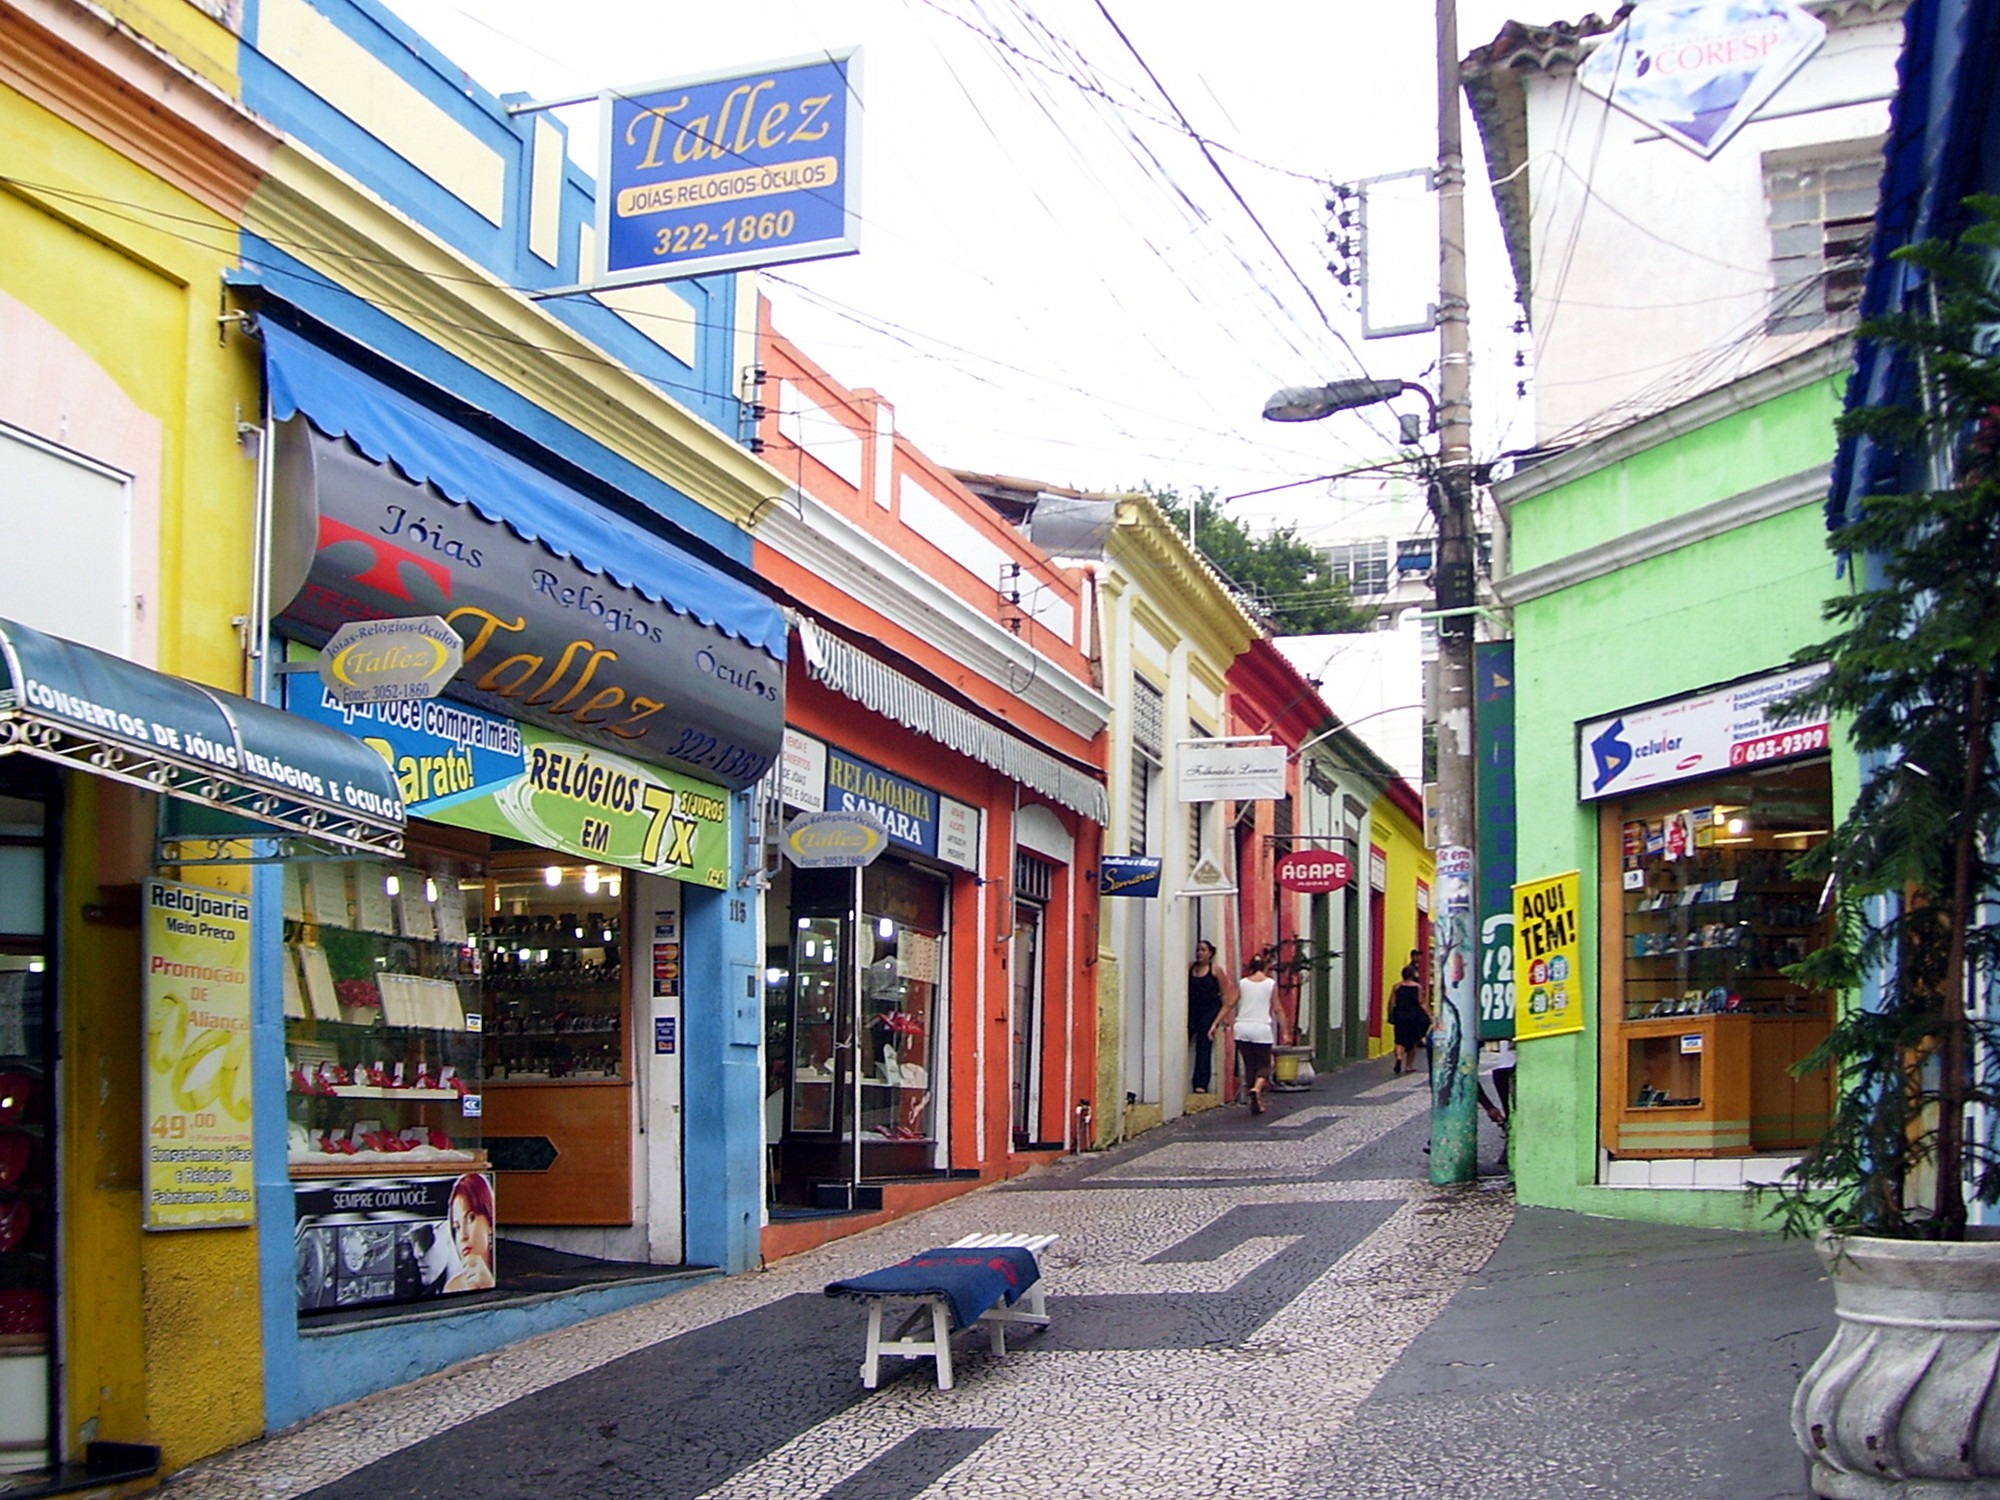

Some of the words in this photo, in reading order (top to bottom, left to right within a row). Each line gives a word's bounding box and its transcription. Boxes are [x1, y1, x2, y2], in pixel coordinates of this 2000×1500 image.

[1656, 31, 1779, 75] CORESP
[625, 80, 833, 170] Tallez
[653, 209, 796, 255] 322-1860
[379, 504, 483, 569] Jóias
[532, 568, 663, 644] Relógios
[695, 645, 777, 702] Óculos
[347, 646, 429, 674] Tallez
[444, 606, 666, 739] Tallez
[372, 683, 429, 699] 3052-1860
[425, 702, 485, 751] compra
[487, 718, 521, 757] mais
[1746, 729, 1823, 762] 623-9399
[26, 679, 149, 740] CONSERTOS
[150, 723, 181, 751] DE
[184, 732, 238, 769] JÓIAS
[244, 752, 324, 797] RELÓGIOS
[330, 781, 341, 801] E
[346, 782, 403, 821] ÓCULOS
[529, 747, 639, 814] RELÓGIOS
[829, 756, 930, 822] RELOJOARIA
[841, 792, 922, 845] SAMARA
[582, 818, 610, 854] EM
[803, 831, 863, 848] Tallez
[1282, 861, 1347, 880] ÁGAPE
[151, 884, 249, 920] Relojoaria
[729, 899, 746, 923] 115
[1522, 883, 1566, 922] AQUI
[165, 917, 196, 935] Meio
[199, 923, 235, 944] Preço
[1521, 910, 1576, 960] TEM!
[151, 956, 245, 987] Promoção
[191, 987, 208, 1001] DE
[151, 1115, 186, 1139] 49
[151, 1146, 222, 1162] Consertamos
[175, 1171, 183, 1183] e
[184, 1167, 232, 1186] Relógios
[151, 1189, 217, 1205] Fabricamos
[333, 1192, 374, 1209] SEMPRE
[375, 1191, 400, 1207] COM
